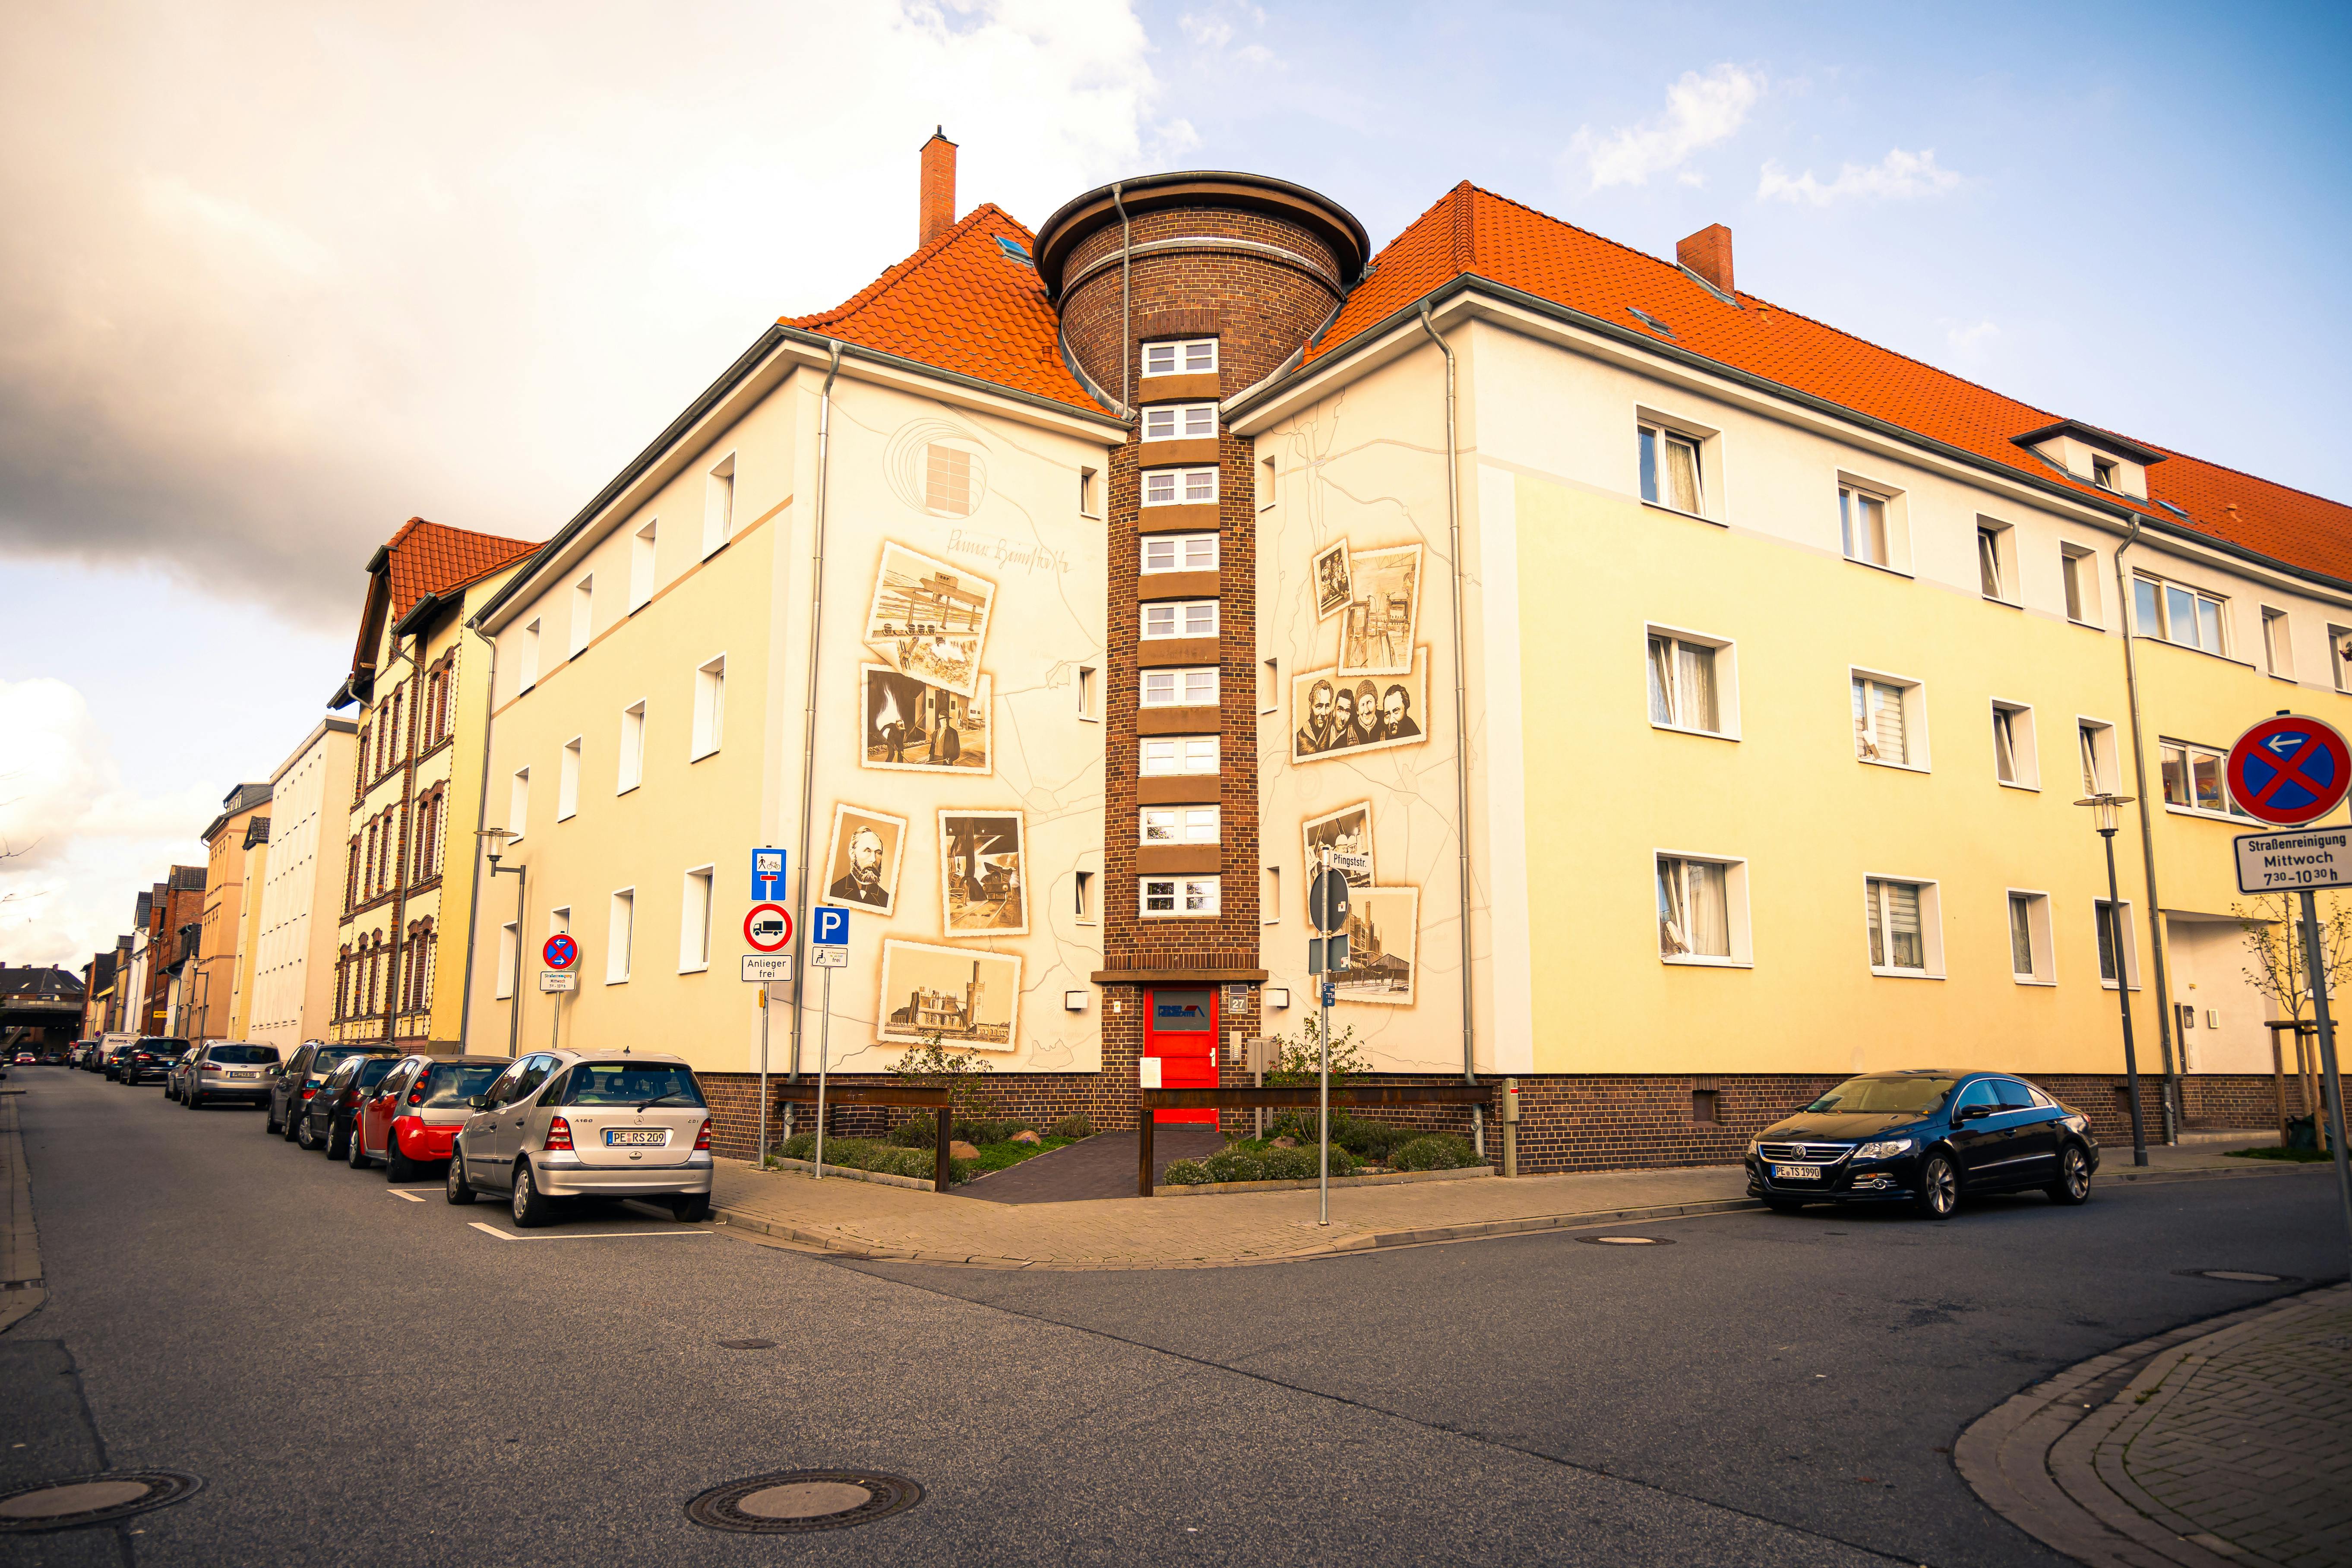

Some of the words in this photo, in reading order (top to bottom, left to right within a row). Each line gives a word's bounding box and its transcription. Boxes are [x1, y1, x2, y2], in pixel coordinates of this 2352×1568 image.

[2248, 834, 2347, 852] Straßenreinigung
[1334, 853, 1367, 868] Pfingststr.
[2263, 851, 2334, 868] Mittwoch
[822, 912, 841, 939] P
[747, 959, 787, 970] Anlieger
[759, 969, 775, 978] frei
[1232, 999, 1245, 1008] 27
[614, 1133, 626, 1142] PE
[632, 1133, 645, 1142] RS
[647, 1133, 664, 1142] 209
[1776, 1166, 1786, 1176] PE
[1789, 1167, 1800, 1176] TS
[1801, 1167, 1820, 1177] 1990
